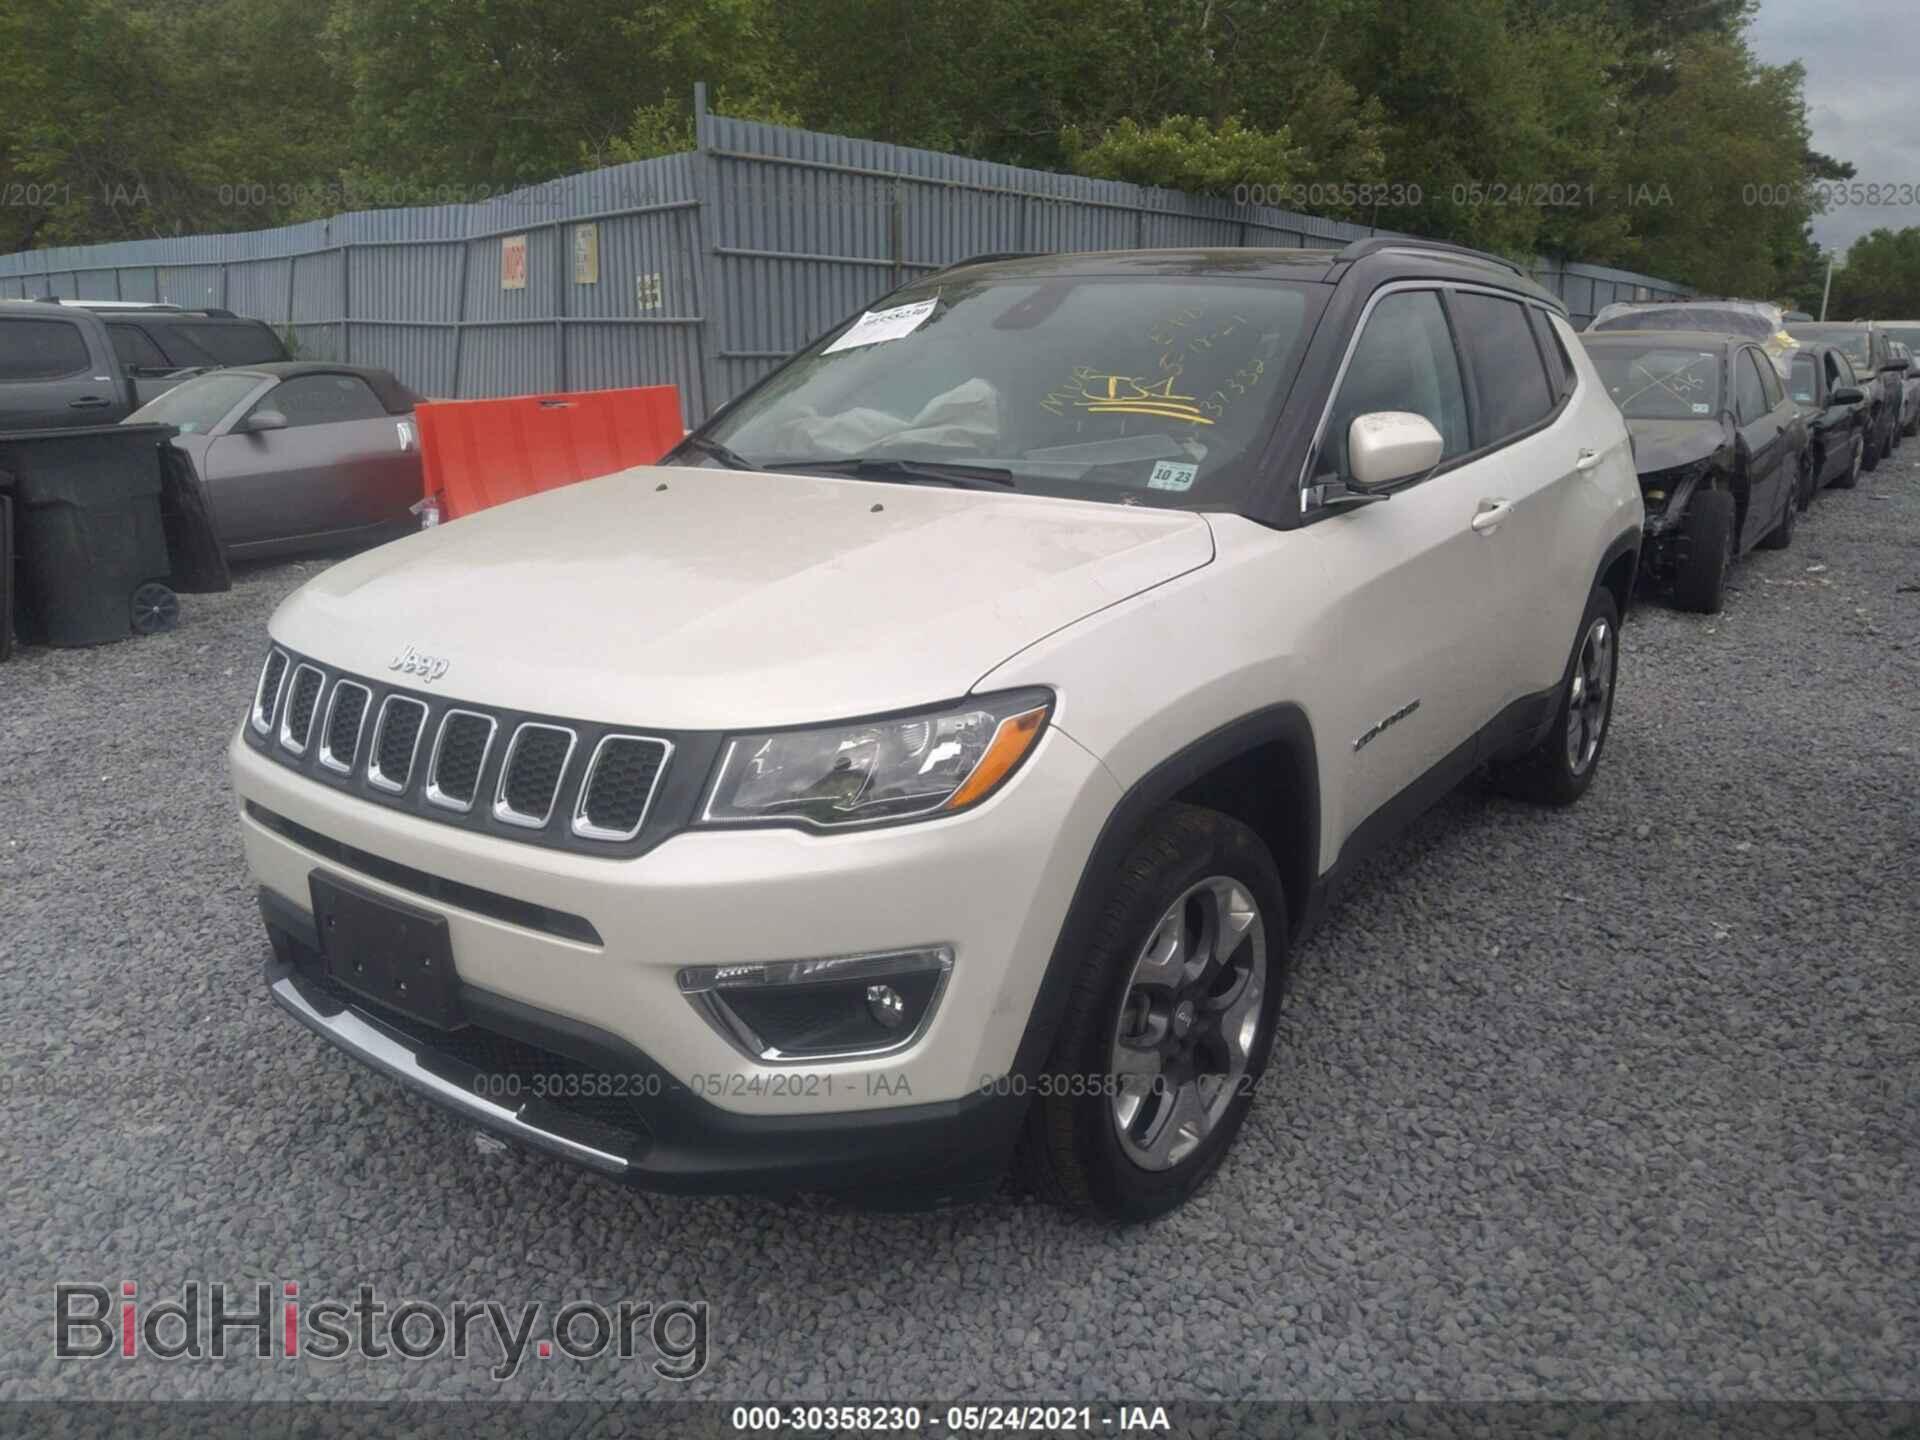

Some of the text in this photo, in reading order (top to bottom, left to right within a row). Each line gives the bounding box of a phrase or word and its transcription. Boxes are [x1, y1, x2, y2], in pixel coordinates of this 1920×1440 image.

[1153, 469, 1192, 483] 10 23
[388, 645, 449, 684] Jeep
